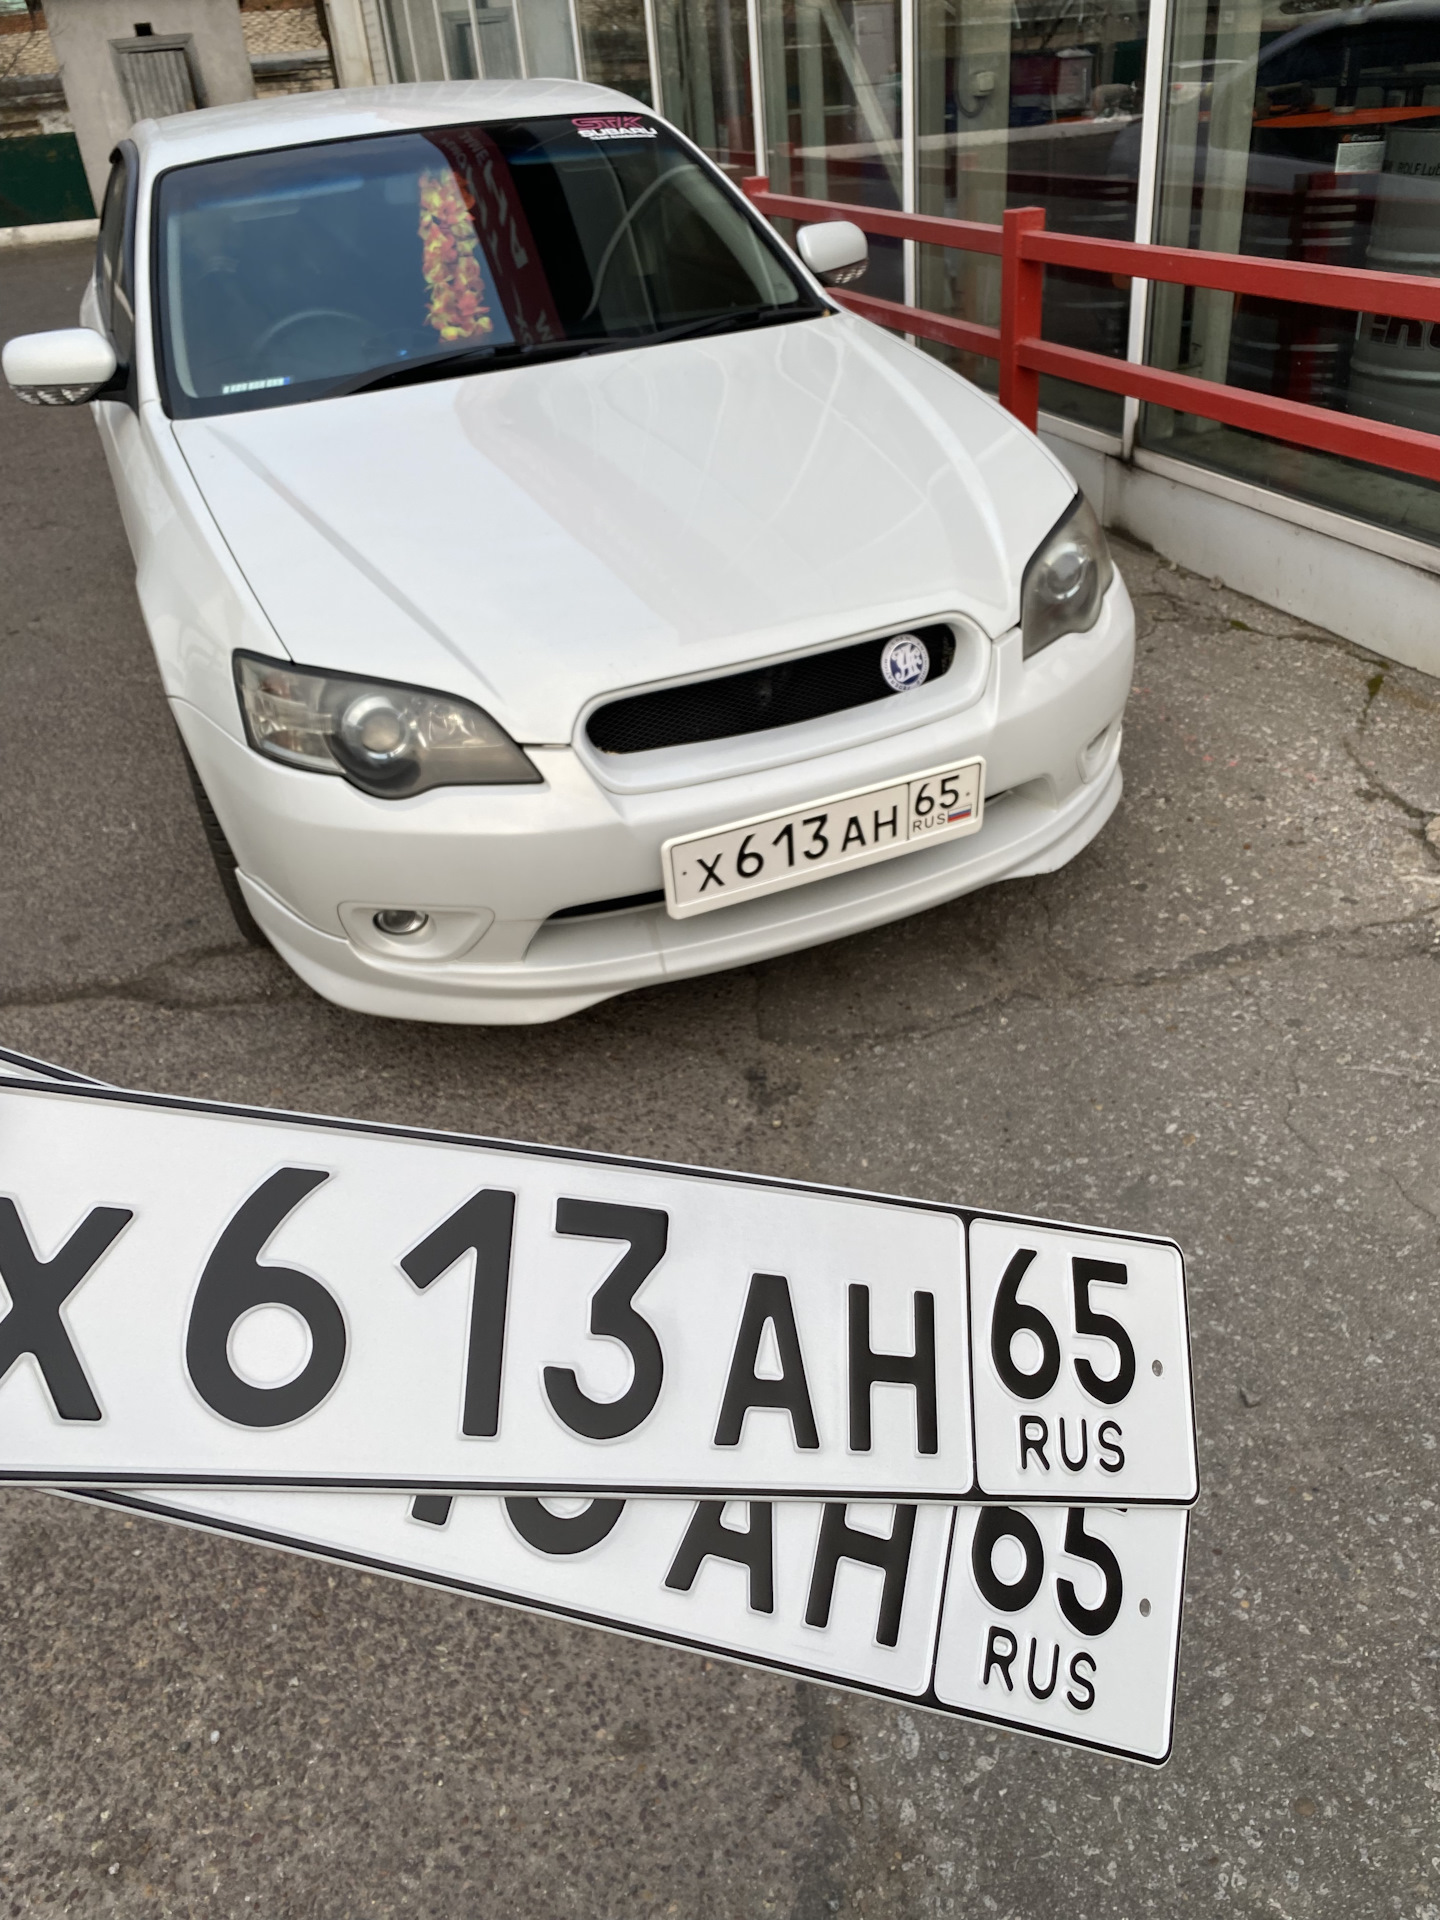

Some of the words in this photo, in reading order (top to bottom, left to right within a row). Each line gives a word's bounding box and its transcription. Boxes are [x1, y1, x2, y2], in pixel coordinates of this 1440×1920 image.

[577, 127, 658, 138] SUBARU
[914, 775, 960, 817] 65
[912, 814, 947, 833] RUS
[991, 1248, 1137, 1405] 65
[1019, 1413, 1126, 1473] RUS
[983, 1625, 1097, 1711] RUS
